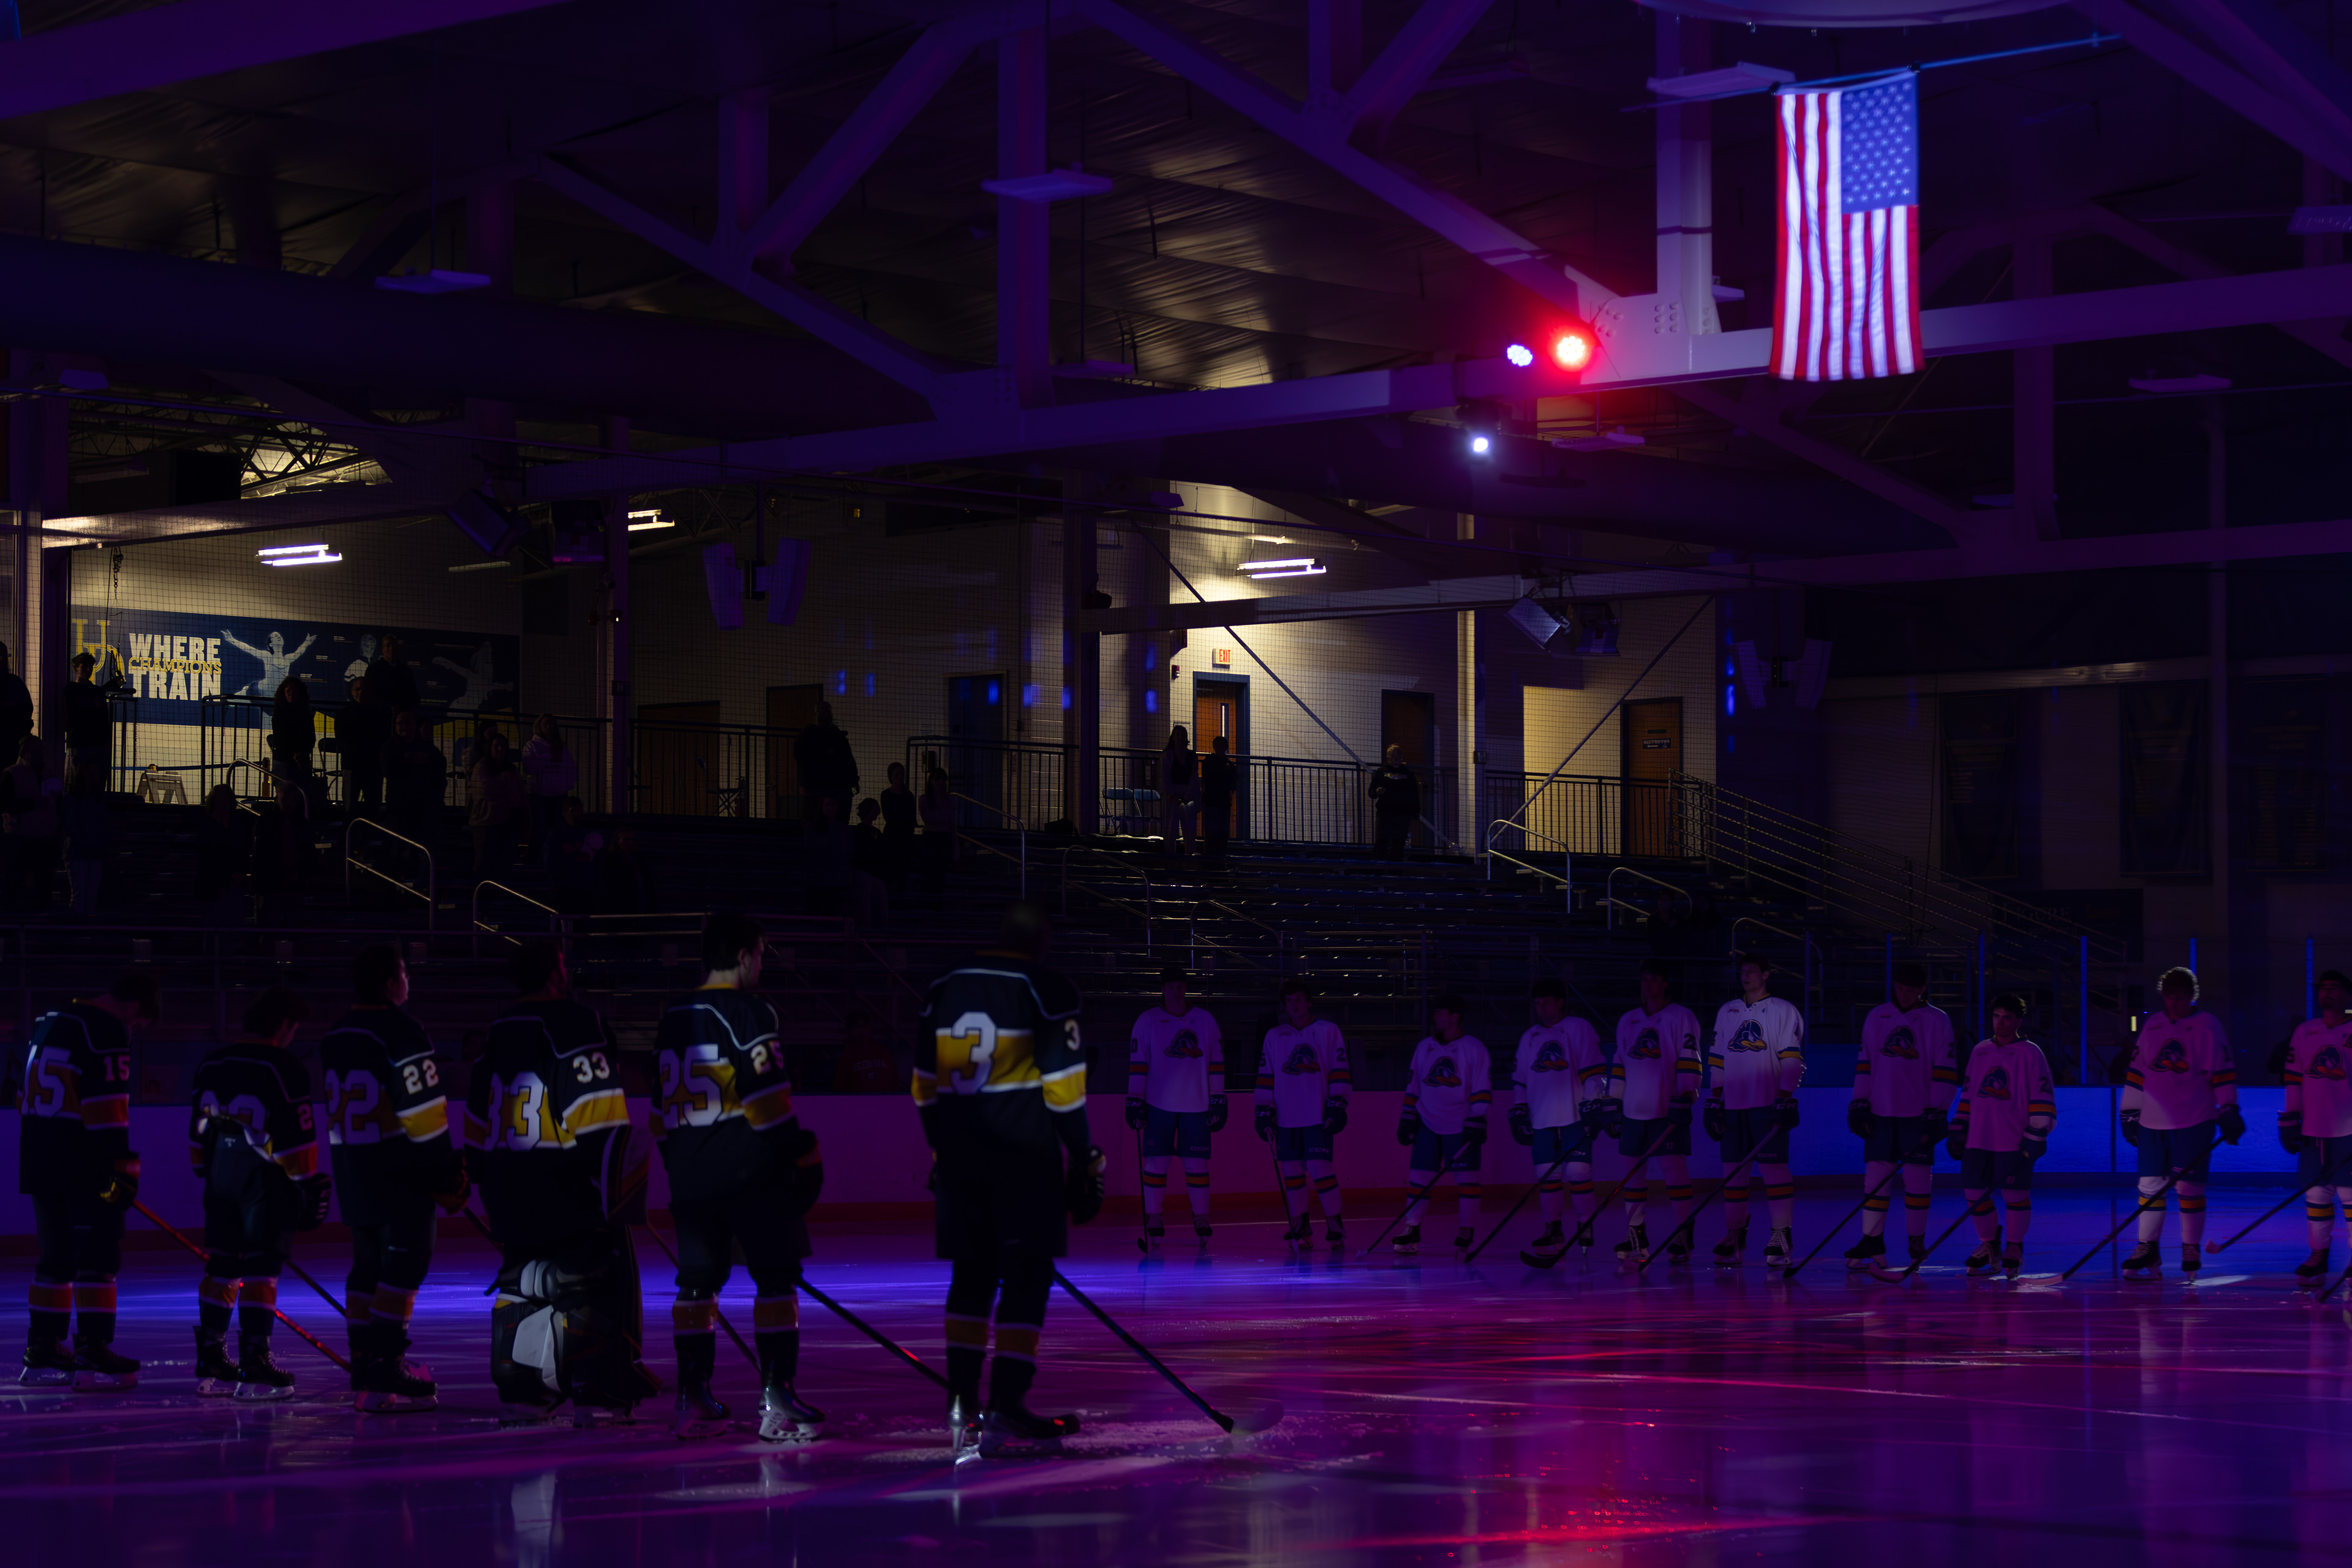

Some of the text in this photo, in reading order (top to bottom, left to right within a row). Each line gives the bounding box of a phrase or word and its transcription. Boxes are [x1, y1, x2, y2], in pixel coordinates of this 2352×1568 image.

[129, 633, 221, 662] WHERE
[1219, 649, 1231, 663] EXIT
[129, 657, 222, 674] CHAMPIONS
[128, 668, 221, 702] TRAIN
[1064, 1018, 1080, 1051] 3
[103, 1055, 130, 1082] 15
[573, 1051, 610, 1084] 33
[951, 1011, 997, 1096] 3
[402, 1058, 439, 1095] 22
[659, 1043, 723, 1130] 25
